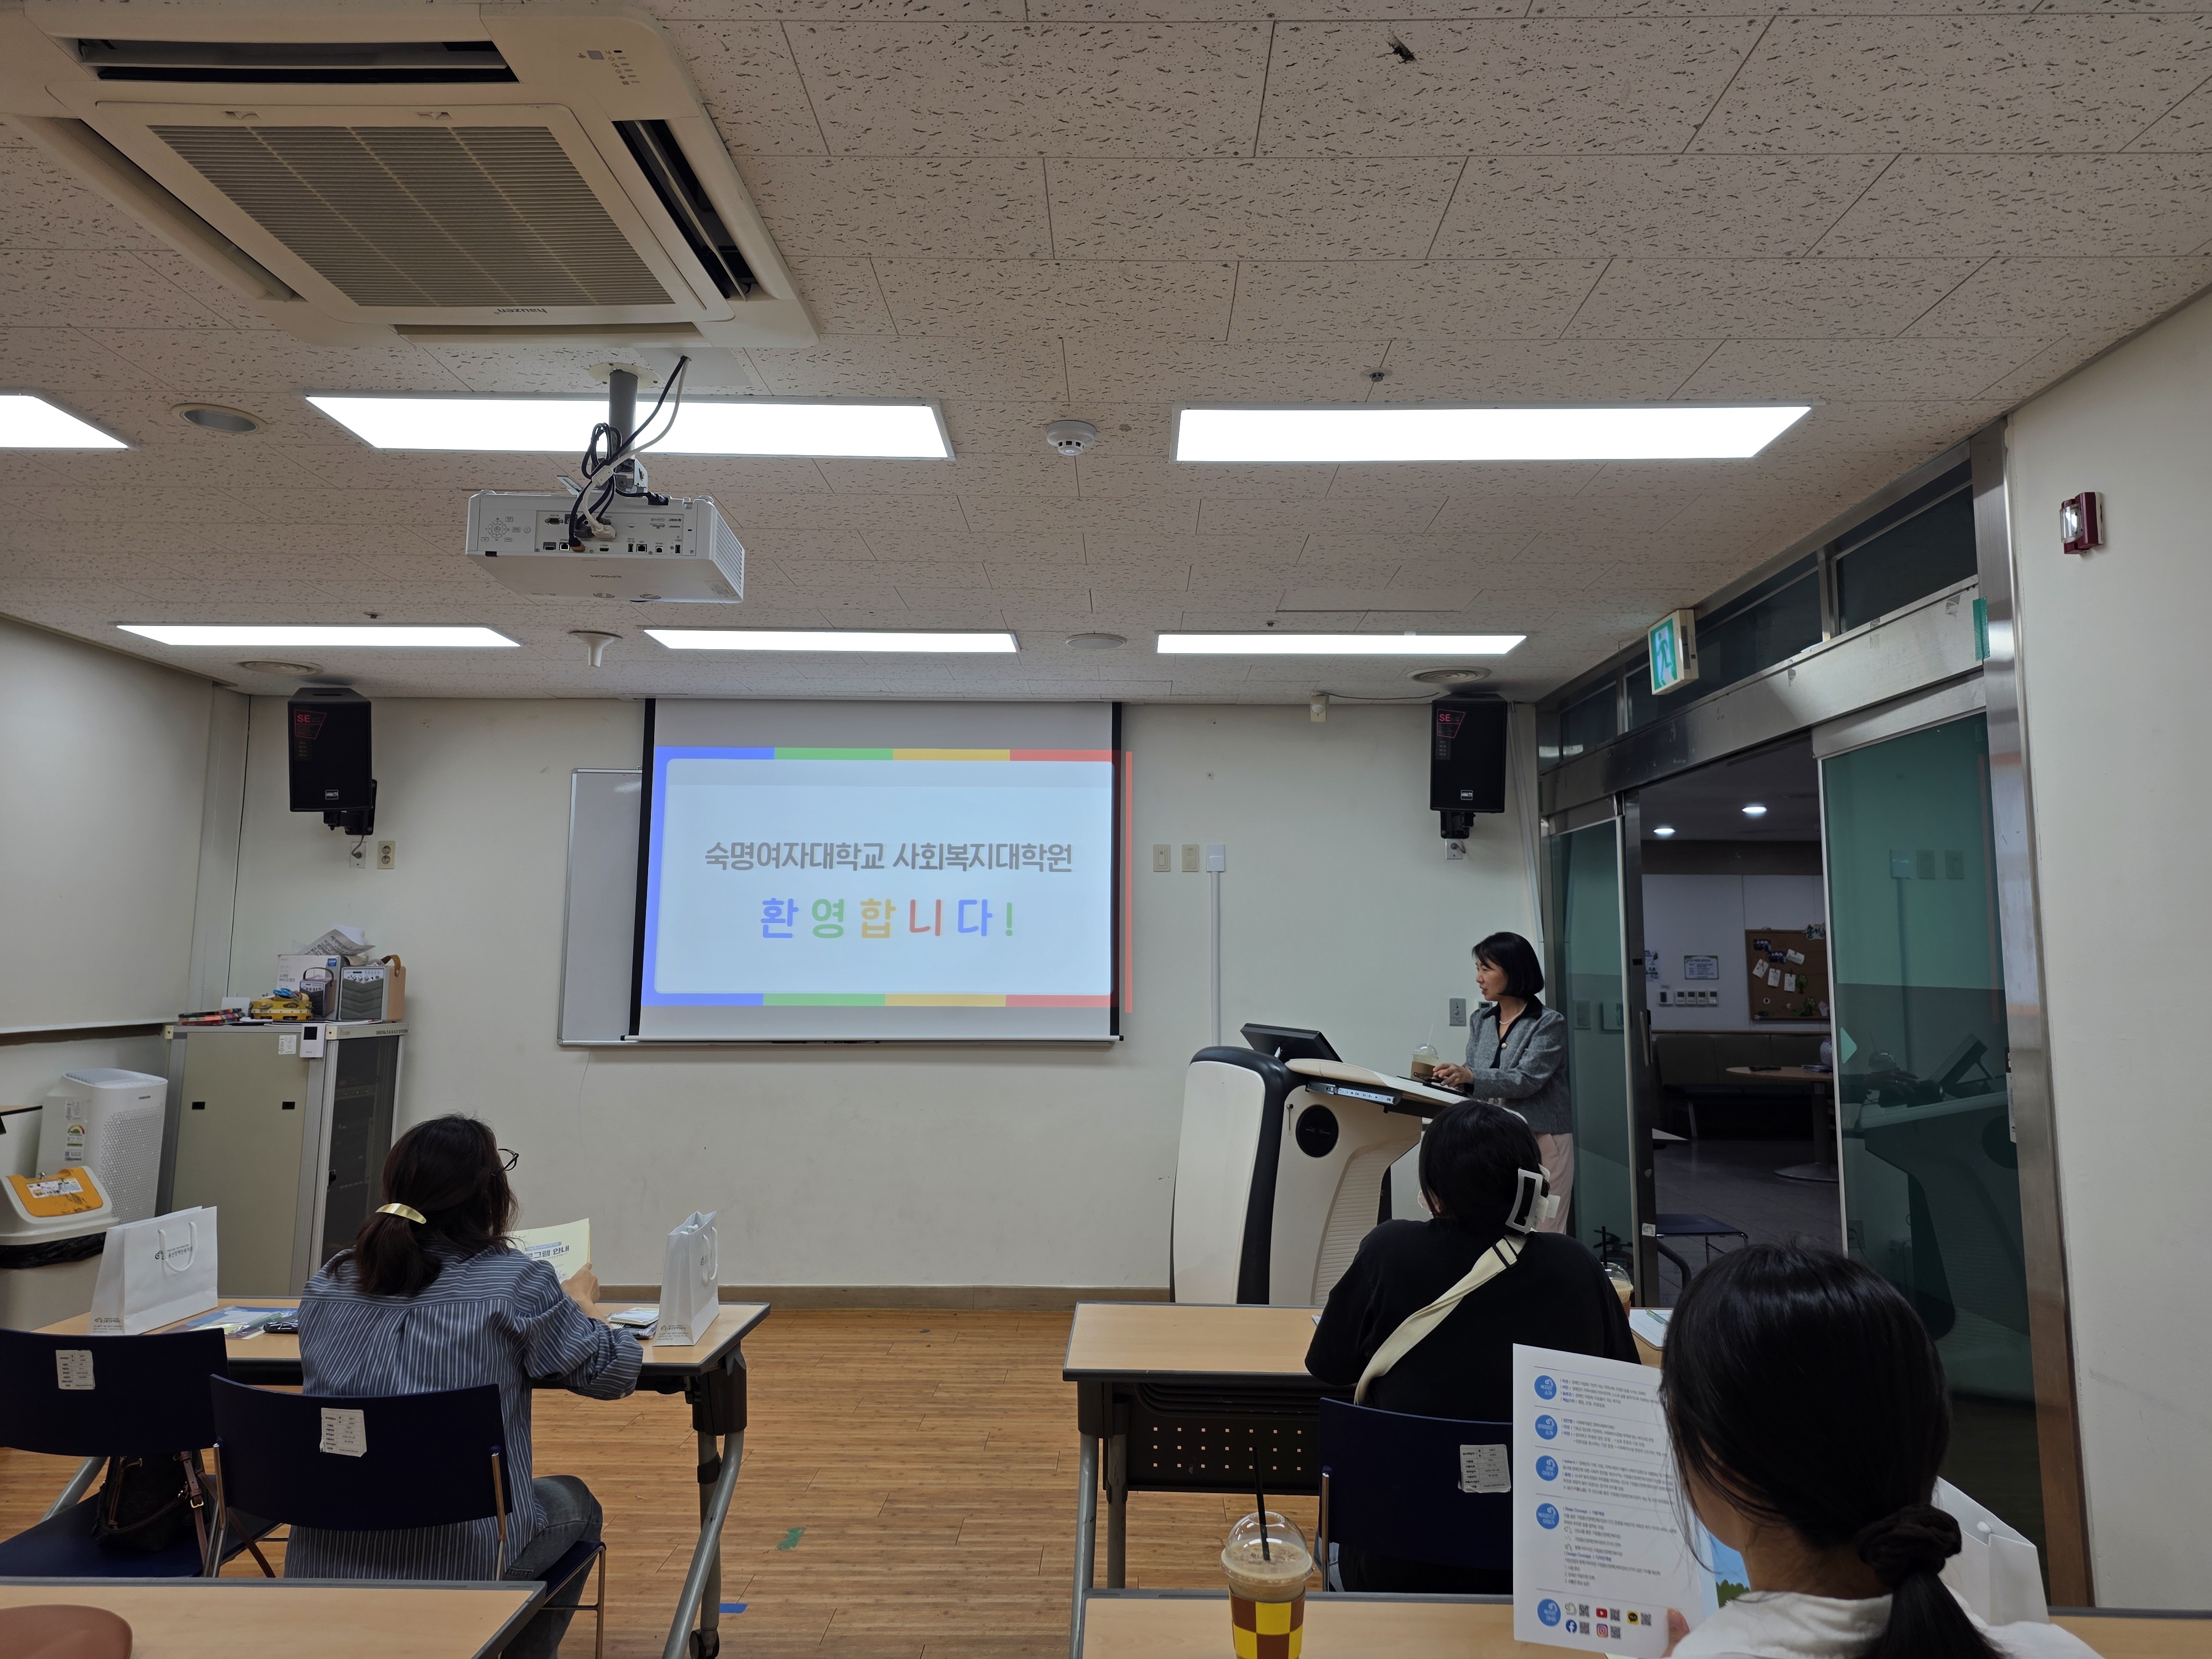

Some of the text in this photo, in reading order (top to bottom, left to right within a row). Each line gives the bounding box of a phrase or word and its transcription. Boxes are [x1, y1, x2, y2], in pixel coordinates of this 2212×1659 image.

[297, 714, 310, 723] SE
[1439, 713, 1451, 722] SE
[704, 842, 1073, 873] 숙명여자대학교 사회복지대학원
[553, 1245, 569, 1255] 안내
